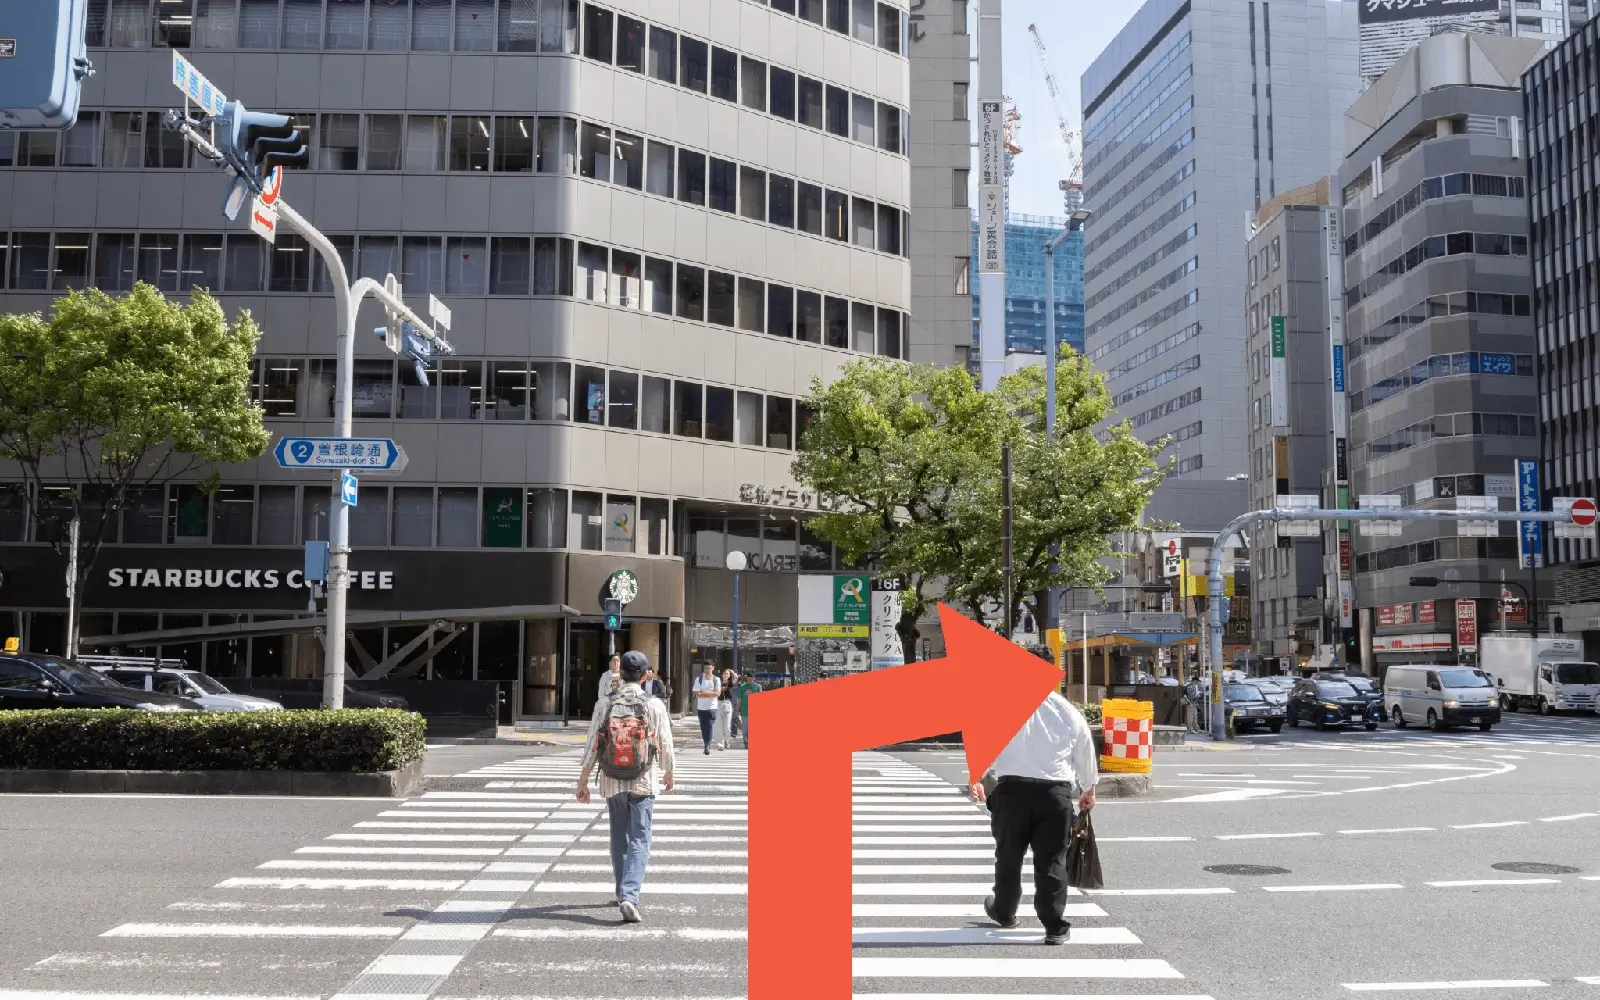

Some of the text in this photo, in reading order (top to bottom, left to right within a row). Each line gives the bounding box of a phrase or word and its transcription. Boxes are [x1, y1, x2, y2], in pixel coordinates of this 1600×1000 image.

[985, 104, 996, 112] 6F
[1483, 362, 1511, 373] エイワ
[298, 444, 307, 457] 2
[318, 443, 381, 457] 曽根崎通
[369, 457, 381, 465] St.
[108, 568, 394, 590] STARBUCKS CFEE
[883, 578, 900, 590] 6F
[882, 594, 893, 654] クリニック
